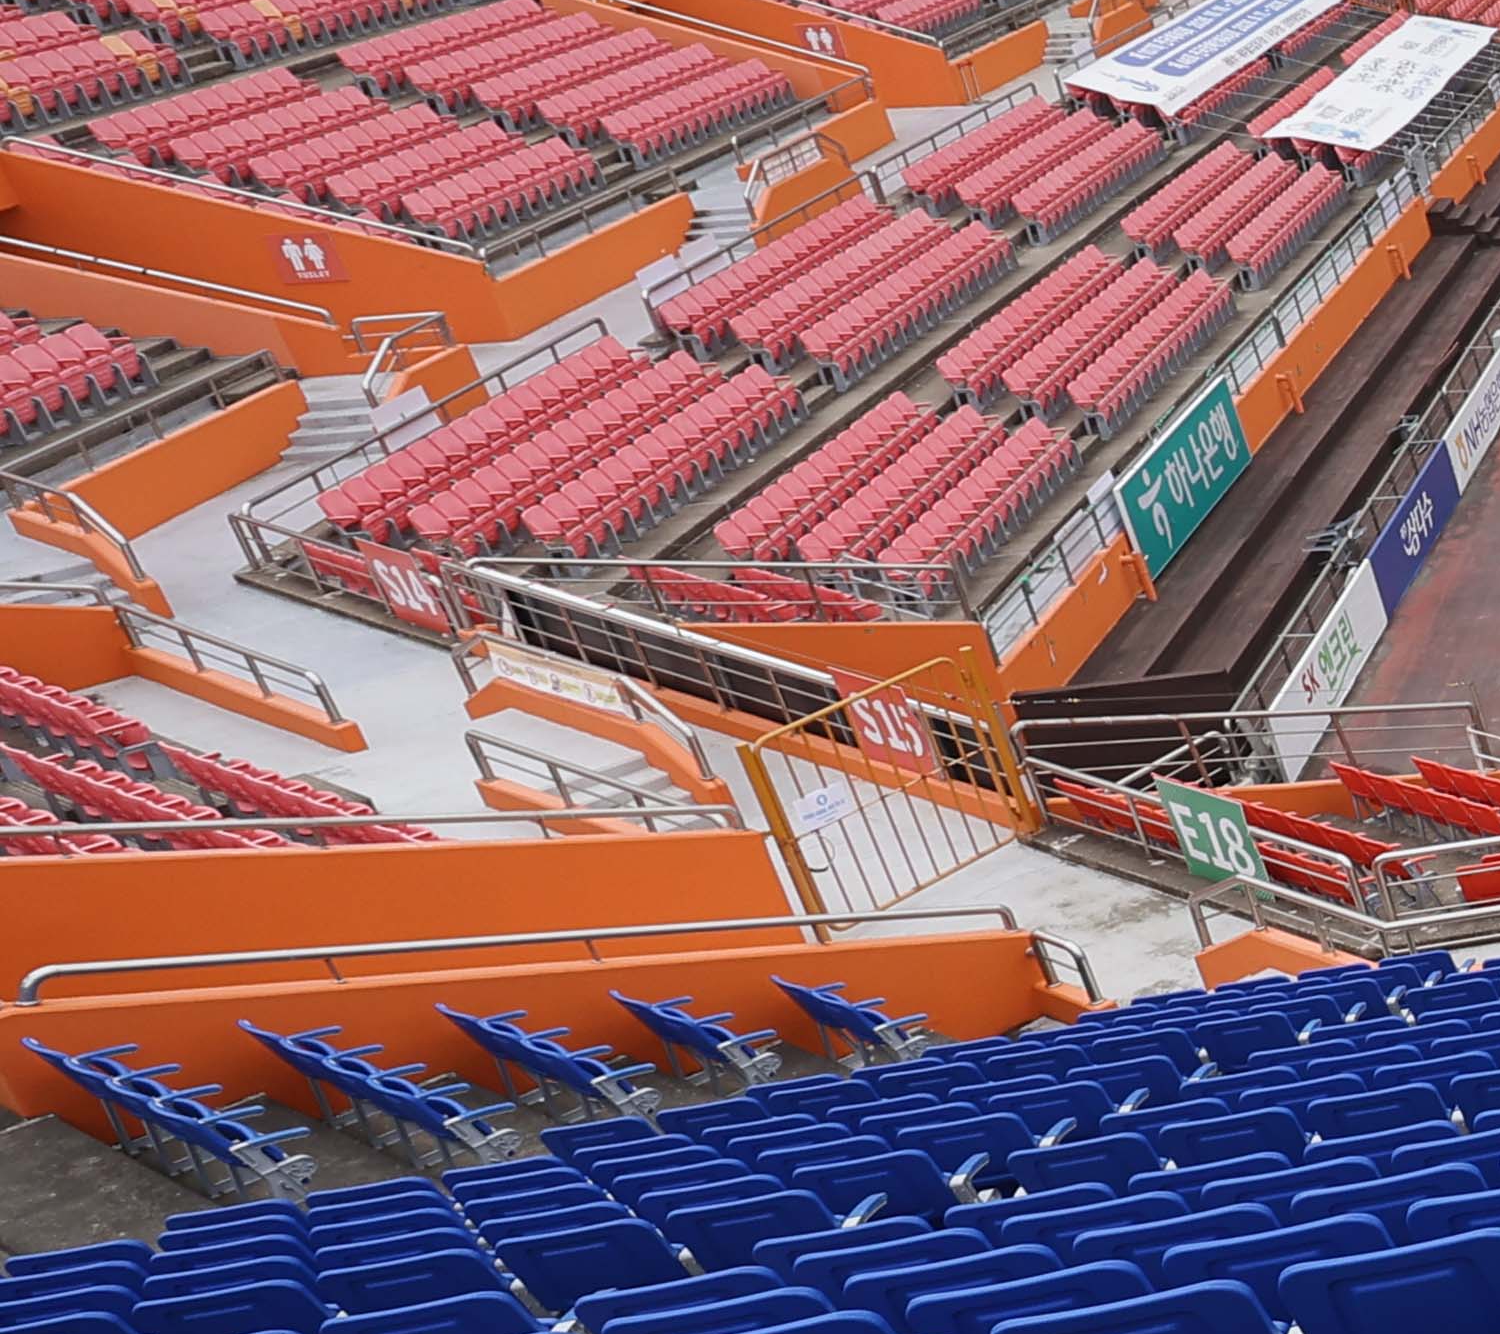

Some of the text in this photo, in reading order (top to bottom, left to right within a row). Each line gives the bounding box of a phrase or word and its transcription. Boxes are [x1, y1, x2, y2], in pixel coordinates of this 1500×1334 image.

[1164, 402, 1237, 507] 하나은행
[372, 559, 438, 616] S14
[1301, 664, 1321, 704] SK
[849, 692, 924, 757] S15
[1168, 801, 1256, 877] E18
